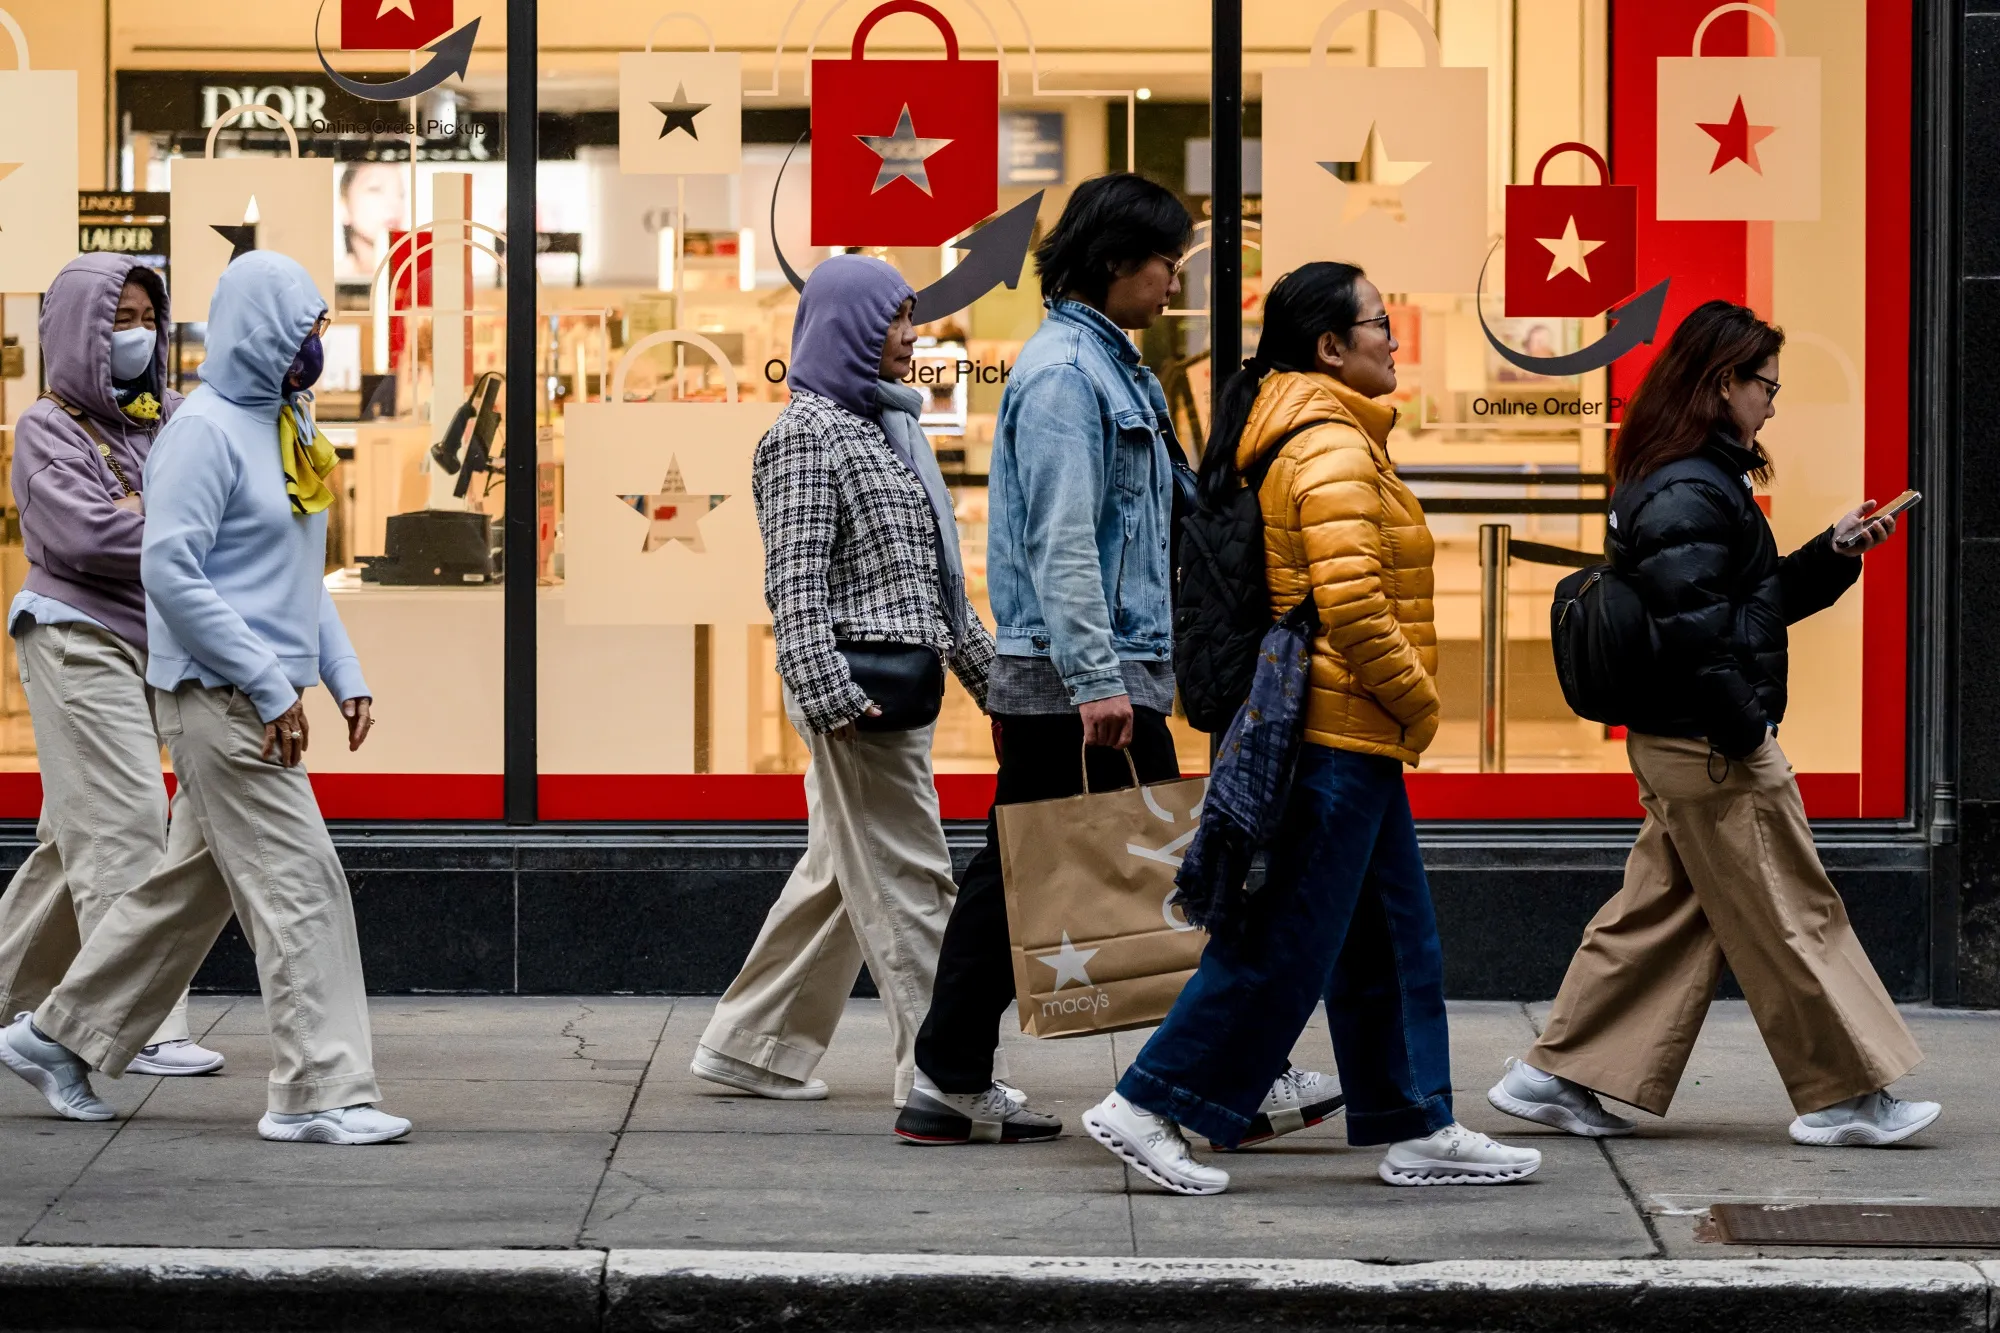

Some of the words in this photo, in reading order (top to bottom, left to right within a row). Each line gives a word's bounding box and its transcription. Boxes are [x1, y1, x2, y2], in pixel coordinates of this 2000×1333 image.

[201, 85, 331, 130] DIOR
[312, 119, 367, 135] Online
[371, 119, 422, 135] Order
[427, 119, 486, 139] Pickup
[901, 360, 947, 384] der
[955, 360, 1012, 384] Pick
[1473, 397, 1537, 415] Online
[1544, 397, 1603, 415] Order
